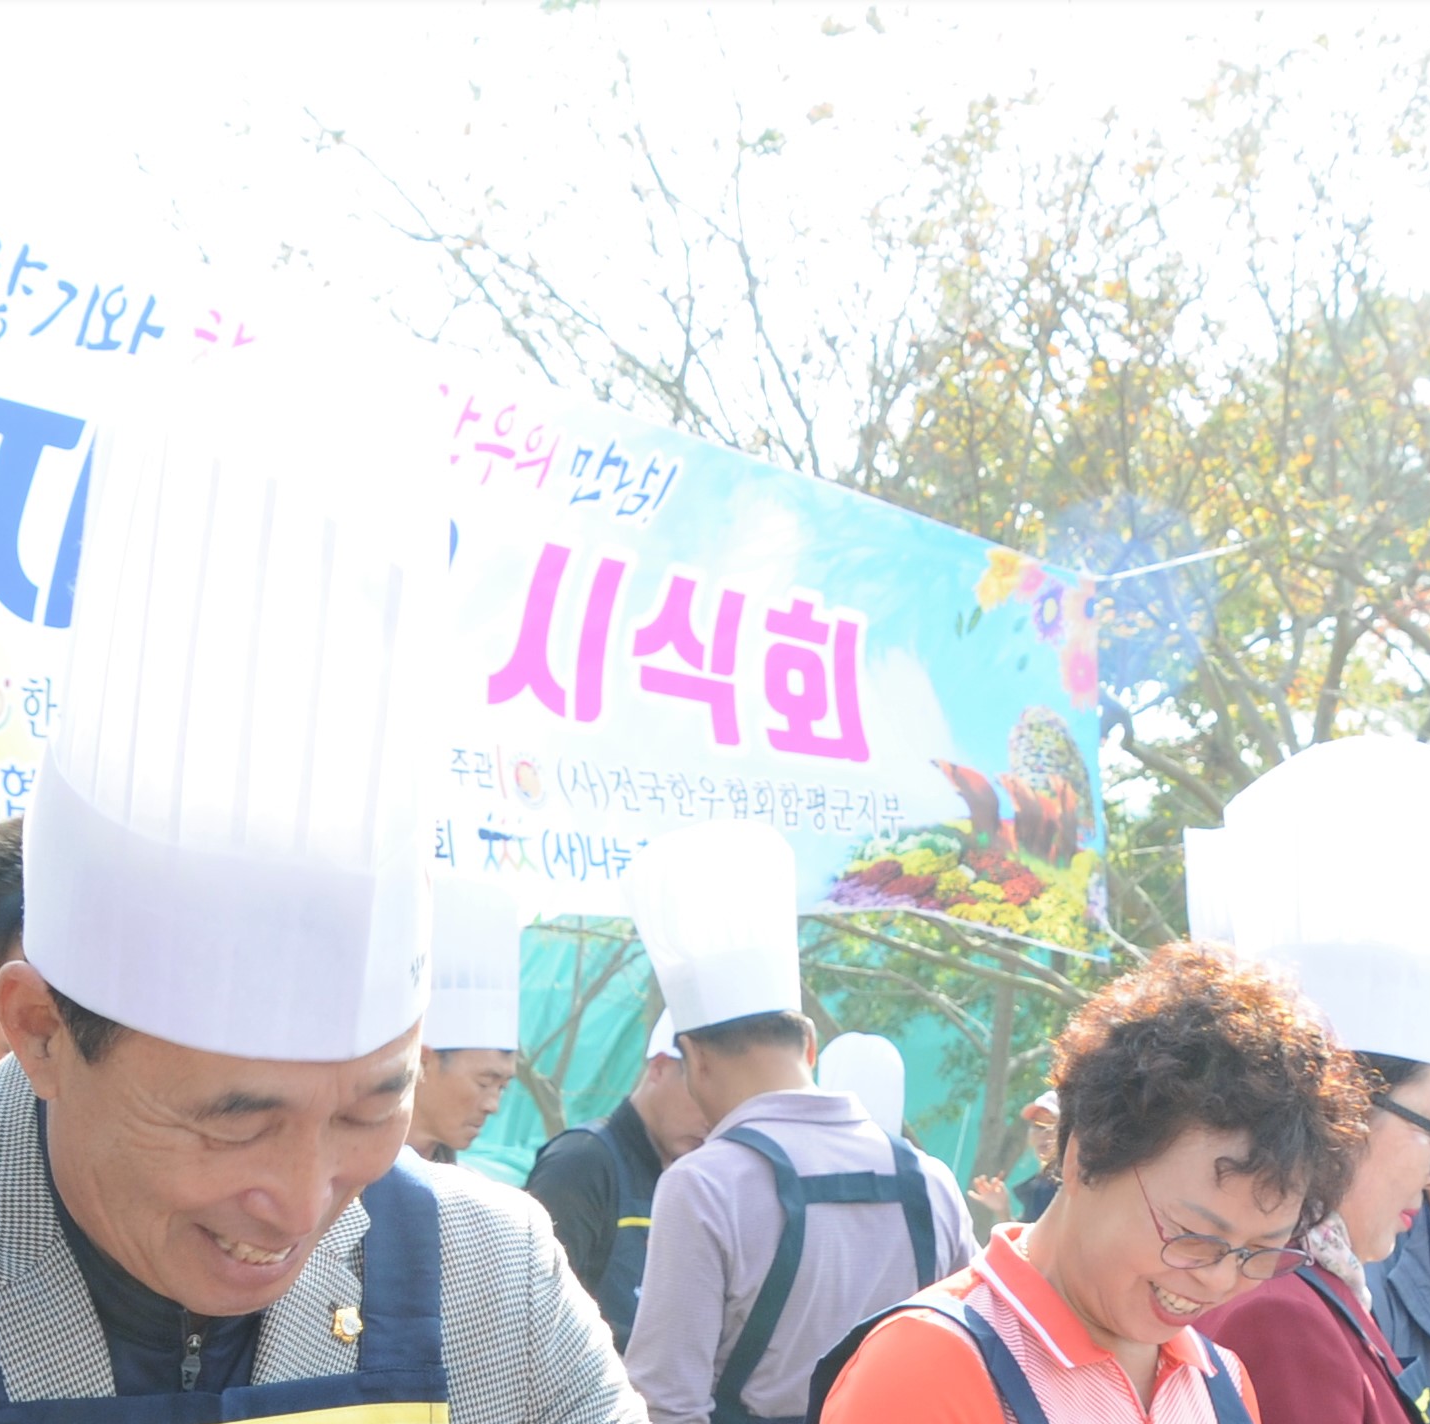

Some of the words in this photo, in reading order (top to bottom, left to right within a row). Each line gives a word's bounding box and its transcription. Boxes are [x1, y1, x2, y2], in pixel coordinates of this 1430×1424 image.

[568, 438, 678, 524] 만남!
[487, 541, 870, 763] 시식회
[21, 676, 60, 739] 한
[450, 747, 495, 789] 주관
[542, 828, 649, 882] (사)나눔
